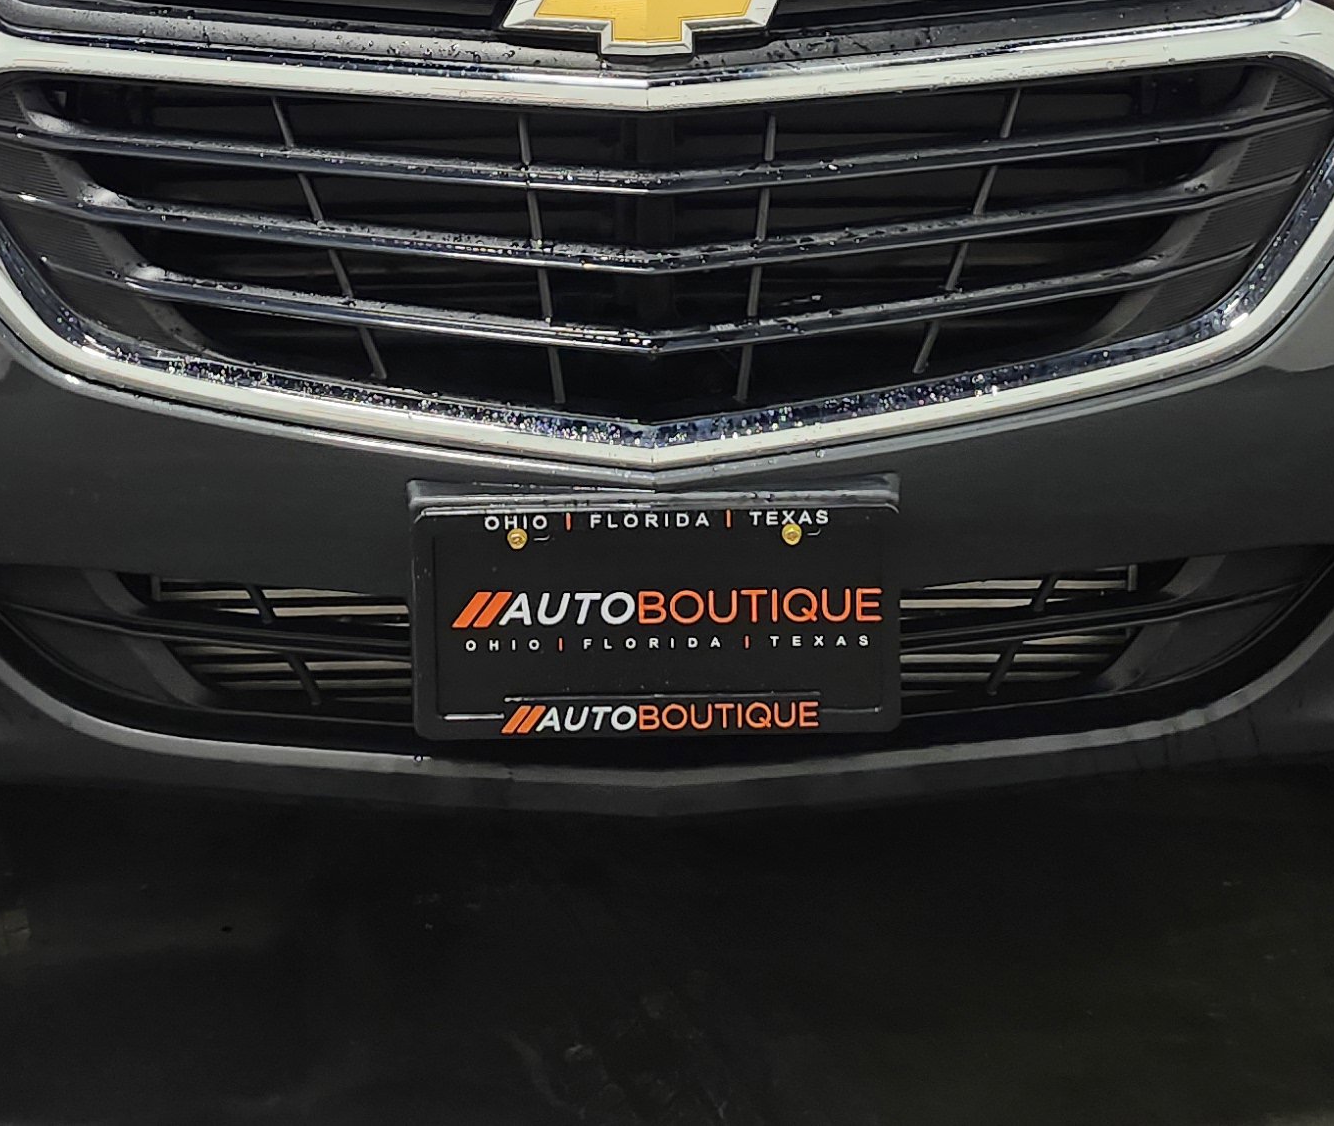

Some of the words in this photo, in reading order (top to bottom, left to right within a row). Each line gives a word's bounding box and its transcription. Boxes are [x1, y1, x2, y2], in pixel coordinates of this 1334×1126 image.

[484, 514, 548, 531] OHIO
[589, 511, 710, 529] FLORIDA
[749, 509, 829, 526] TEXAS
[465, 638, 540, 651] OHIO
[583, 637, 721, 650] FLORIDA
[769, 634, 869, 648] TEXAS
